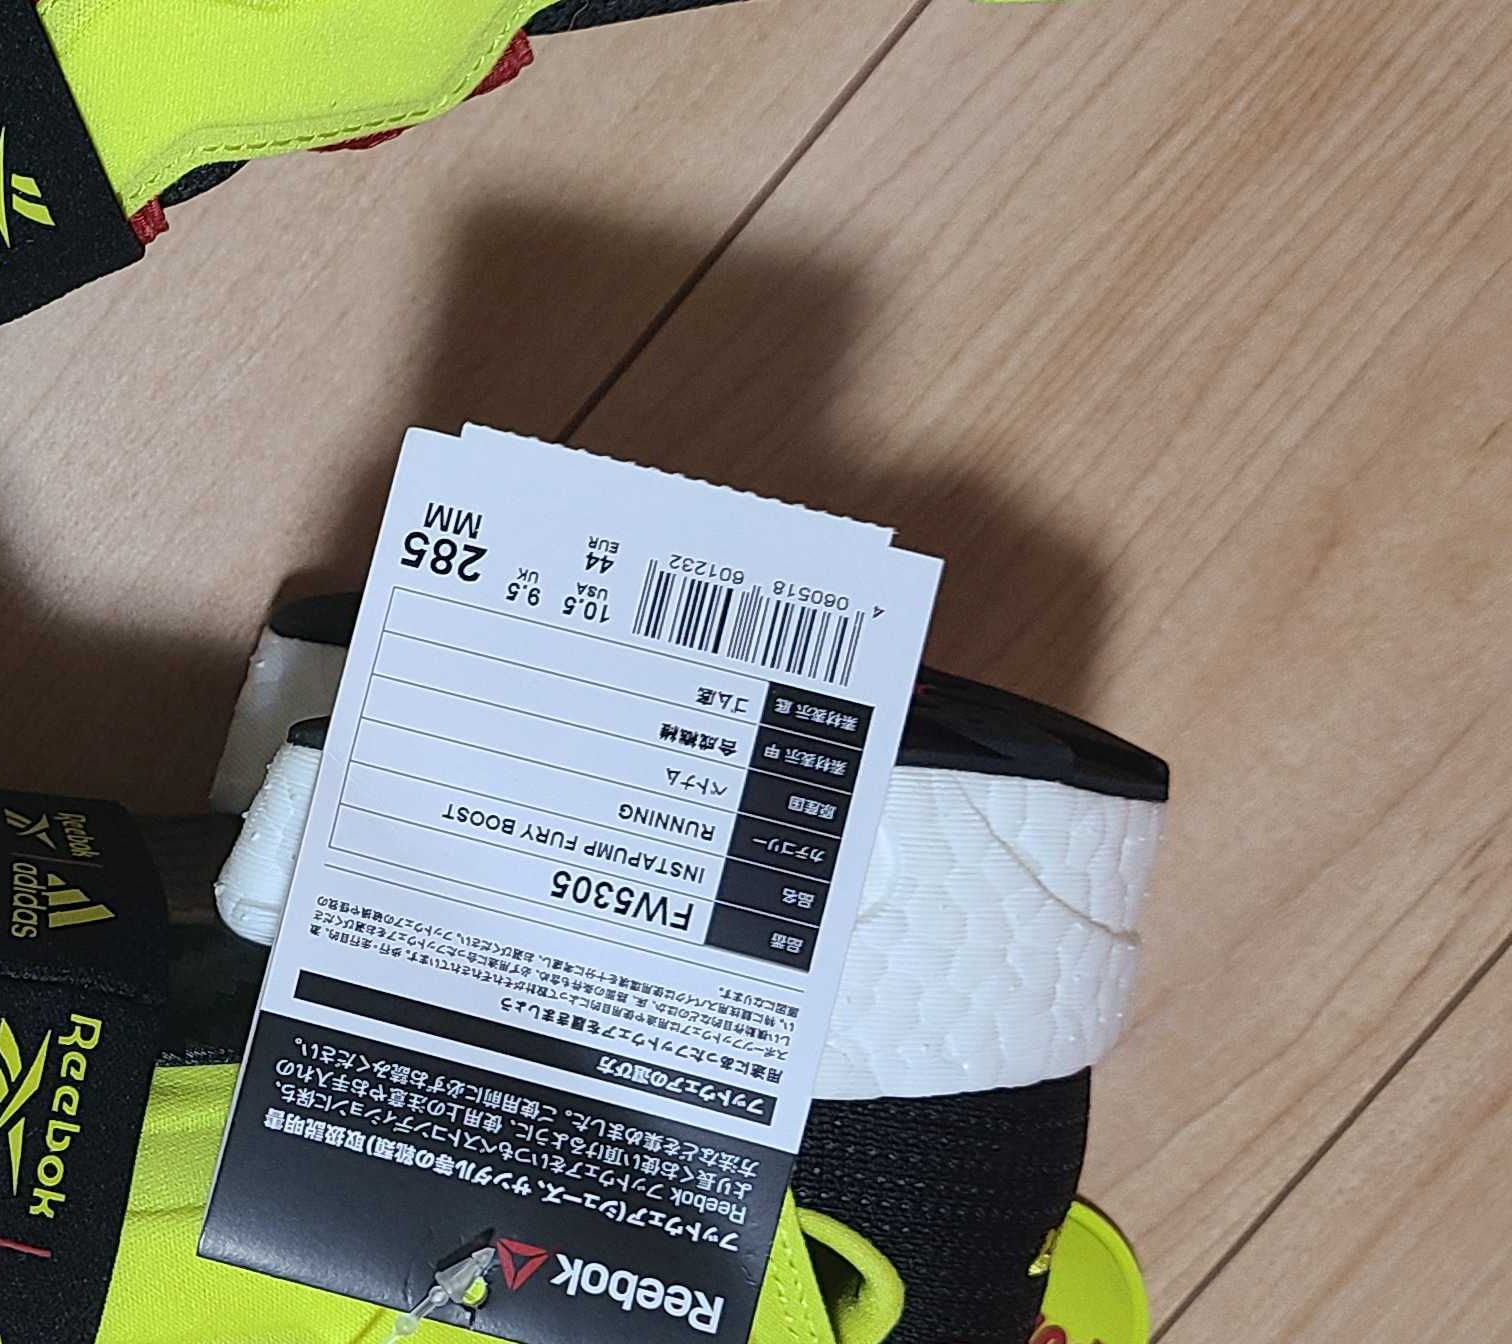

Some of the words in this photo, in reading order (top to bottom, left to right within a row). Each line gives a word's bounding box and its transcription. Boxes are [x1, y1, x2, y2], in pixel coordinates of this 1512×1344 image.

[423, 502, 483, 540] MM
[400, 531, 488, 582] 285
[588, 535, 620, 555] EUR
[516, 567, 539, 584] UK
[585, 551, 614, 574] 44
[668, 553, 745, 585] 601232
[505, 582, 541, 607] 9.5
[576, 582, 608, 601] USA
[772, 580, 849, 611] 060518
[562, 596, 610, 624] 10.5
[872, 605, 885, 619] 4
[695, 687, 749, 714] ゴム底
[795, 704, 859, 732] 素材表示
[659, 723, 737, 757] 合成繊維
[763, 743, 781, 759] 甲
[784, 748, 848, 776] 素材表示
[666, 767, 728, 796] ベトナム
[444, 803, 516, 836] BOOST
[787, 795, 837, 820] 原産国
[53, 812, 101, 859] Reebok
[618, 803, 716, 842] RUNNING
[519, 823, 579, 852] FURY
[752, 838, 825, 863] カテゴリー
[583, 840, 705, 884] INSTAPUMP
[10, 862, 47, 938] adidas
[550, 870, 694, 931] FW5305
[782, 887, 815, 909] 品名
[770, 932, 804, 954] 品番
[596, 1055, 764, 1115] フットウェアの選び方
[29, 1014, 101, 1216] Reebok
[670, 1187, 747, 1225] Reebok
[550, 1253, 725, 1334] Reebok
